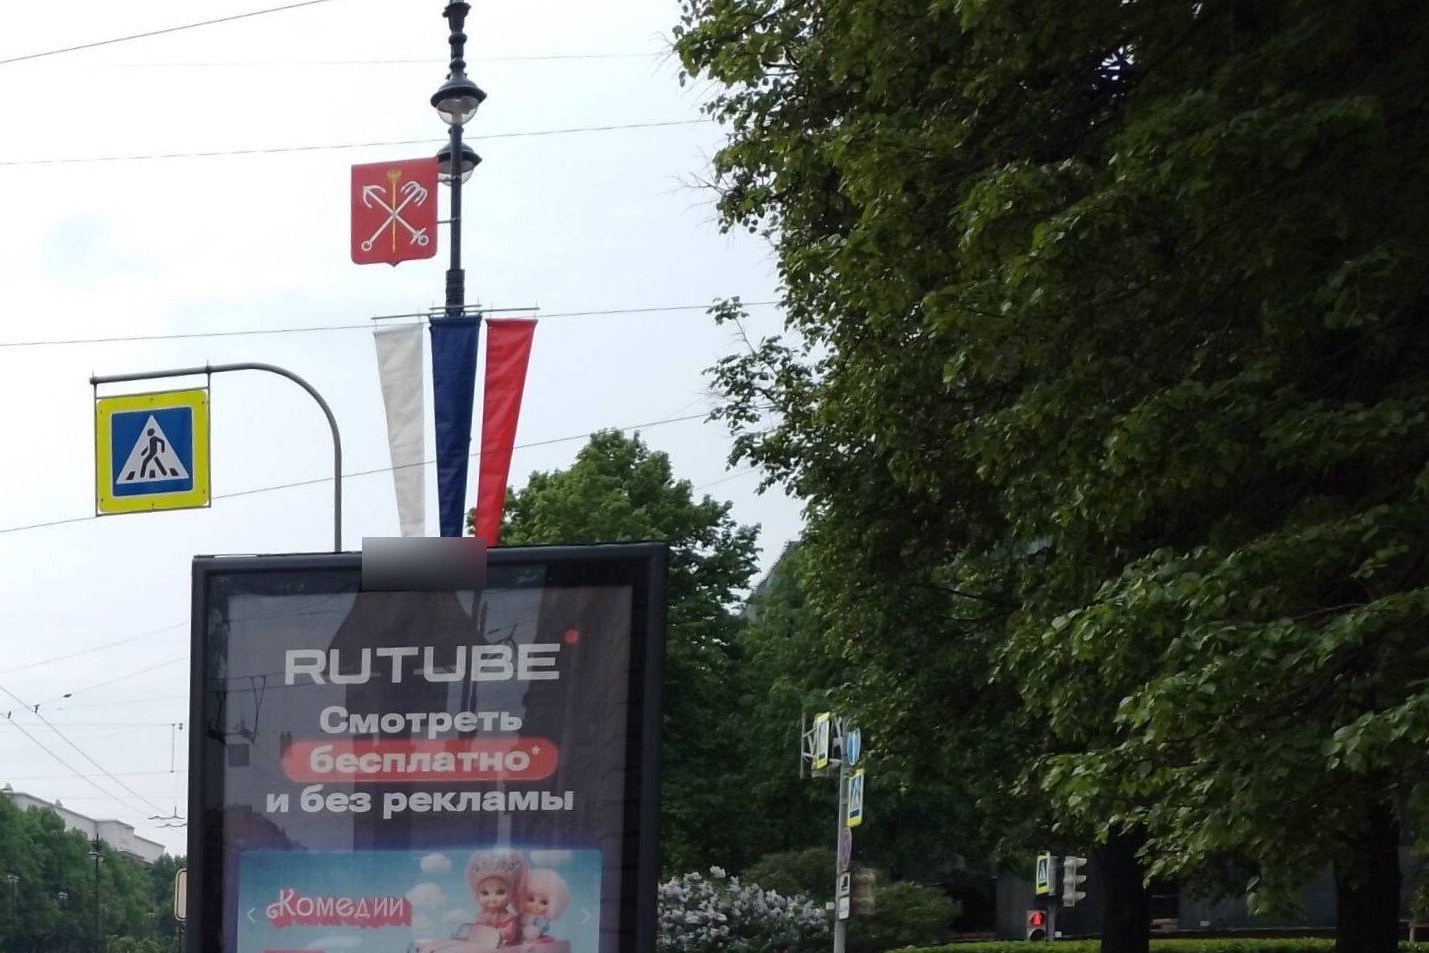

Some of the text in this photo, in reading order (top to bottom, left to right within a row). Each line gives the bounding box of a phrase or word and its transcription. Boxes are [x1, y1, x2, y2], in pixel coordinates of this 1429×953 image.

[284, 642, 561, 685] RUTUBE
[320, 705, 523, 739] Смотреть
[266, 784, 574, 819] и без рекламы
[266, 888, 404, 920] Комедии
